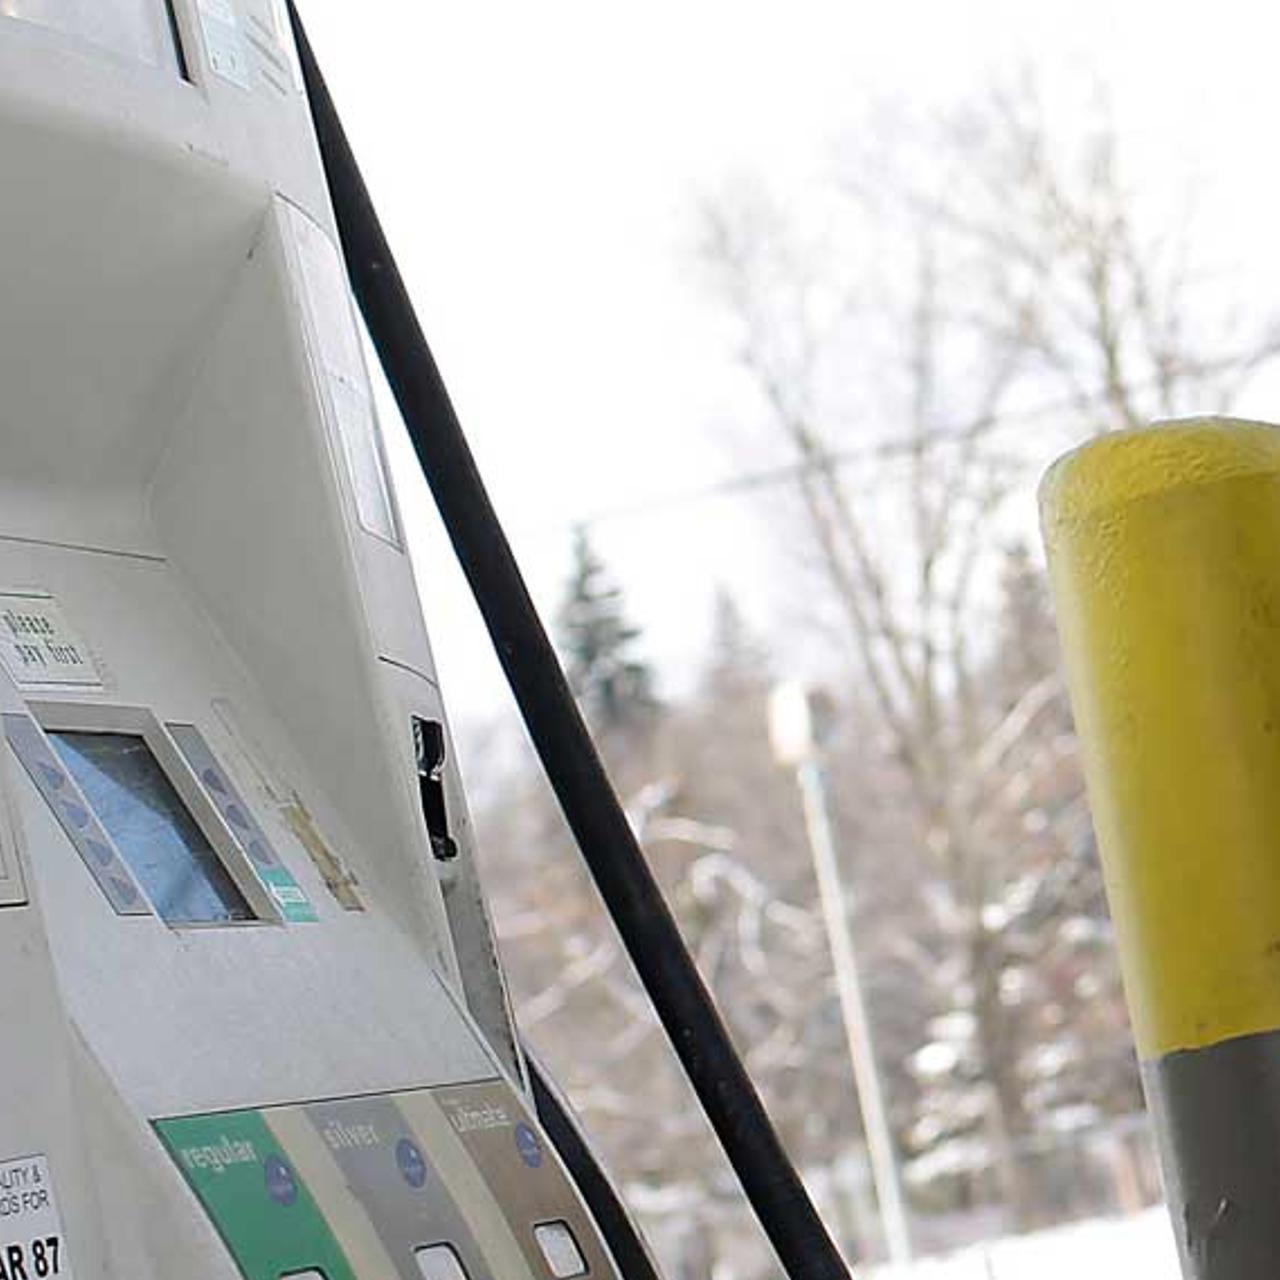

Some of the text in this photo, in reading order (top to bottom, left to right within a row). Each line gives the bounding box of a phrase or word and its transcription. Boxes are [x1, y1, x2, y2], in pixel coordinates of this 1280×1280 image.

[181, 1133, 256, 1173] regular
[322, 1120, 381, 1151] silver
[22, 1189, 50, 1211] FOR
[32, 1236, 60, 1278] 87
